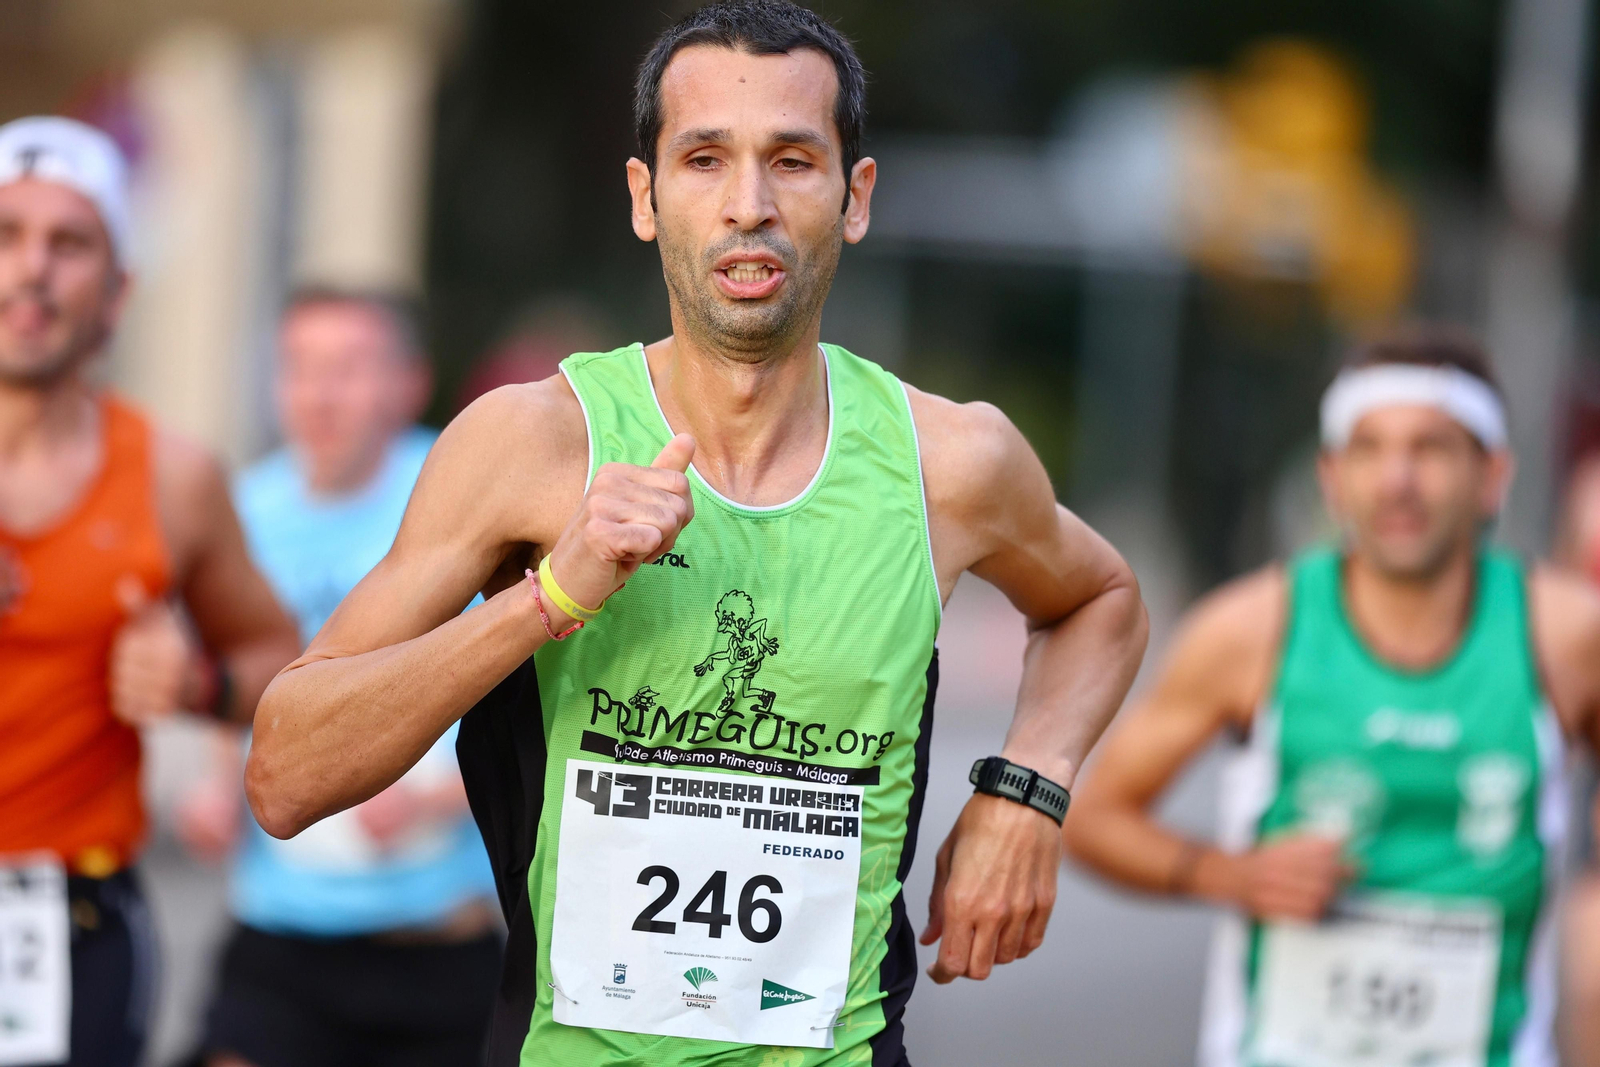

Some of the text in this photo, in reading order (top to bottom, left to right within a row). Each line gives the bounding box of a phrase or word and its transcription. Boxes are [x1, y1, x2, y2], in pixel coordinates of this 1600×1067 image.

[652, 749, 715, 763] Atletismo
[719, 752, 782, 774] Primeguis
[796, 765, 848, 785] Málaga
[575, 769, 653, 819] 43
[656, 776, 860, 812] CARRERA URBANA
[654, 799, 858, 837] CIUDAD DE MÁLAGA
[763, 844, 844, 860] FEDERADO
[631, 865, 783, 943] 246
[602, 985, 636, 994] Ayuntamiento
[682, 991, 717, 1000] Fundación
[686, 1001, 711, 1010] Unicaja
